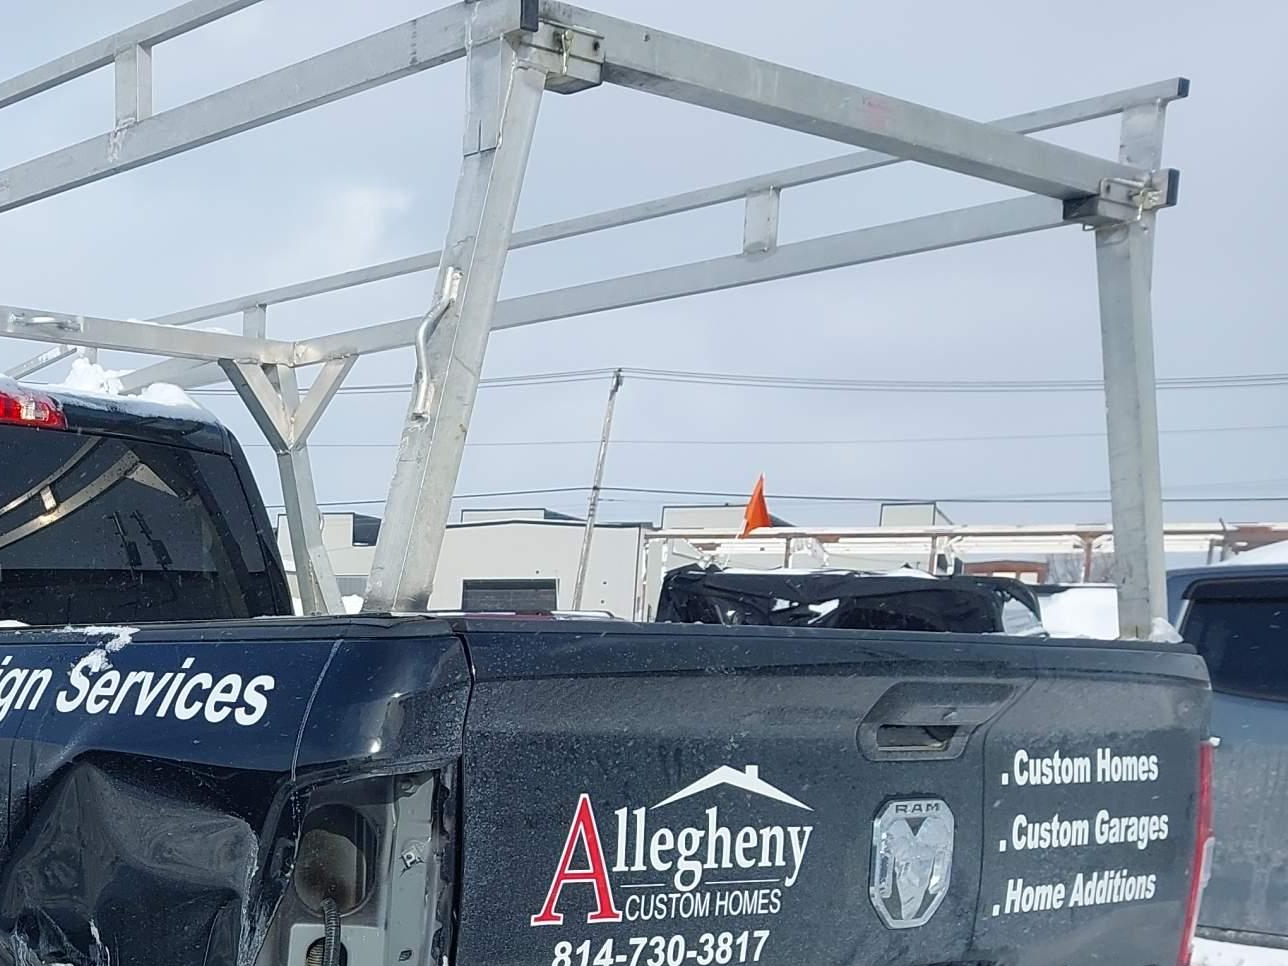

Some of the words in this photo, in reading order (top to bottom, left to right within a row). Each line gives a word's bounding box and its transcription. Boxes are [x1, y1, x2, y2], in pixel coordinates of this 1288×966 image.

[56, 657, 275, 726] Services
[1096, 748, 1159, 782] Homes
[895, 803, 940, 813] RAM
[1095, 810, 1169, 850] Garages
[531, 793, 813, 926] Allegheny
[1068, 869, 1156, 901] Additions
[625, 893, 710, 921] CUSTOM
[715, 889, 781, 916] HOMES
